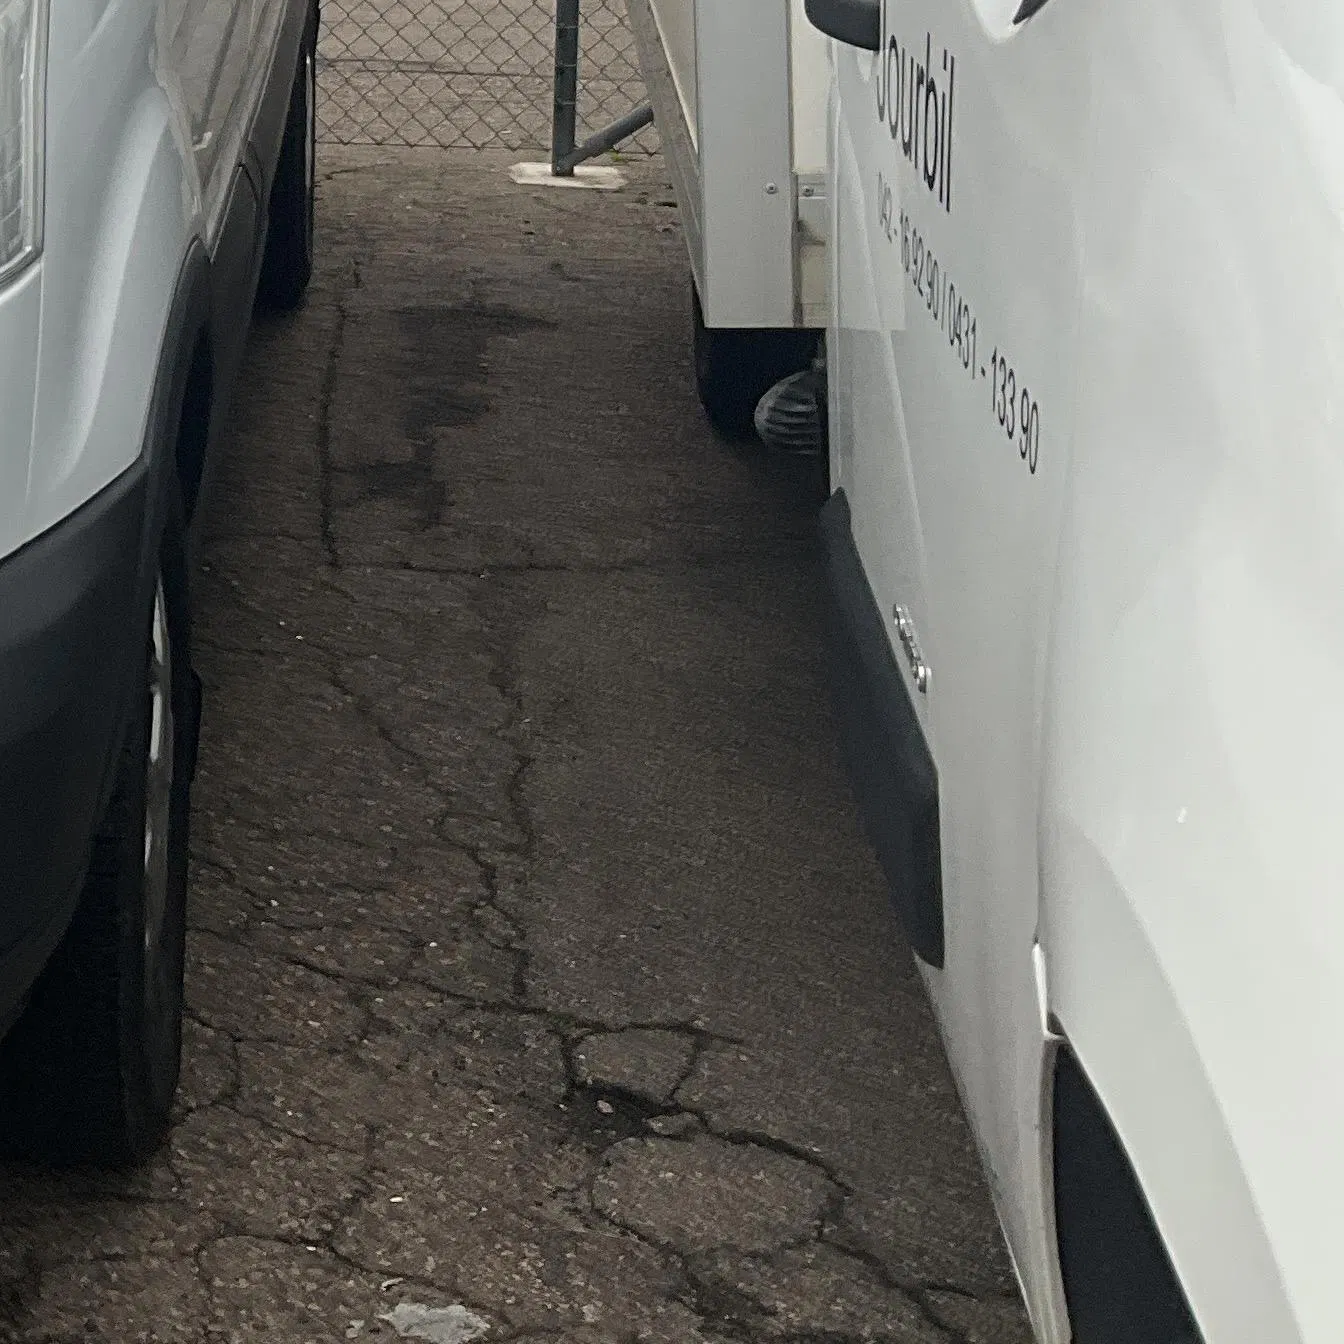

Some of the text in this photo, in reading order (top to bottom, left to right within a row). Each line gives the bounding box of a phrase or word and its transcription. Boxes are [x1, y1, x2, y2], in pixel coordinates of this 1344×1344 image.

[948, 282, 977, 380] 0431
[991, 345, 1016, 441] 133
[1019, 387, 1040, 475] 90
